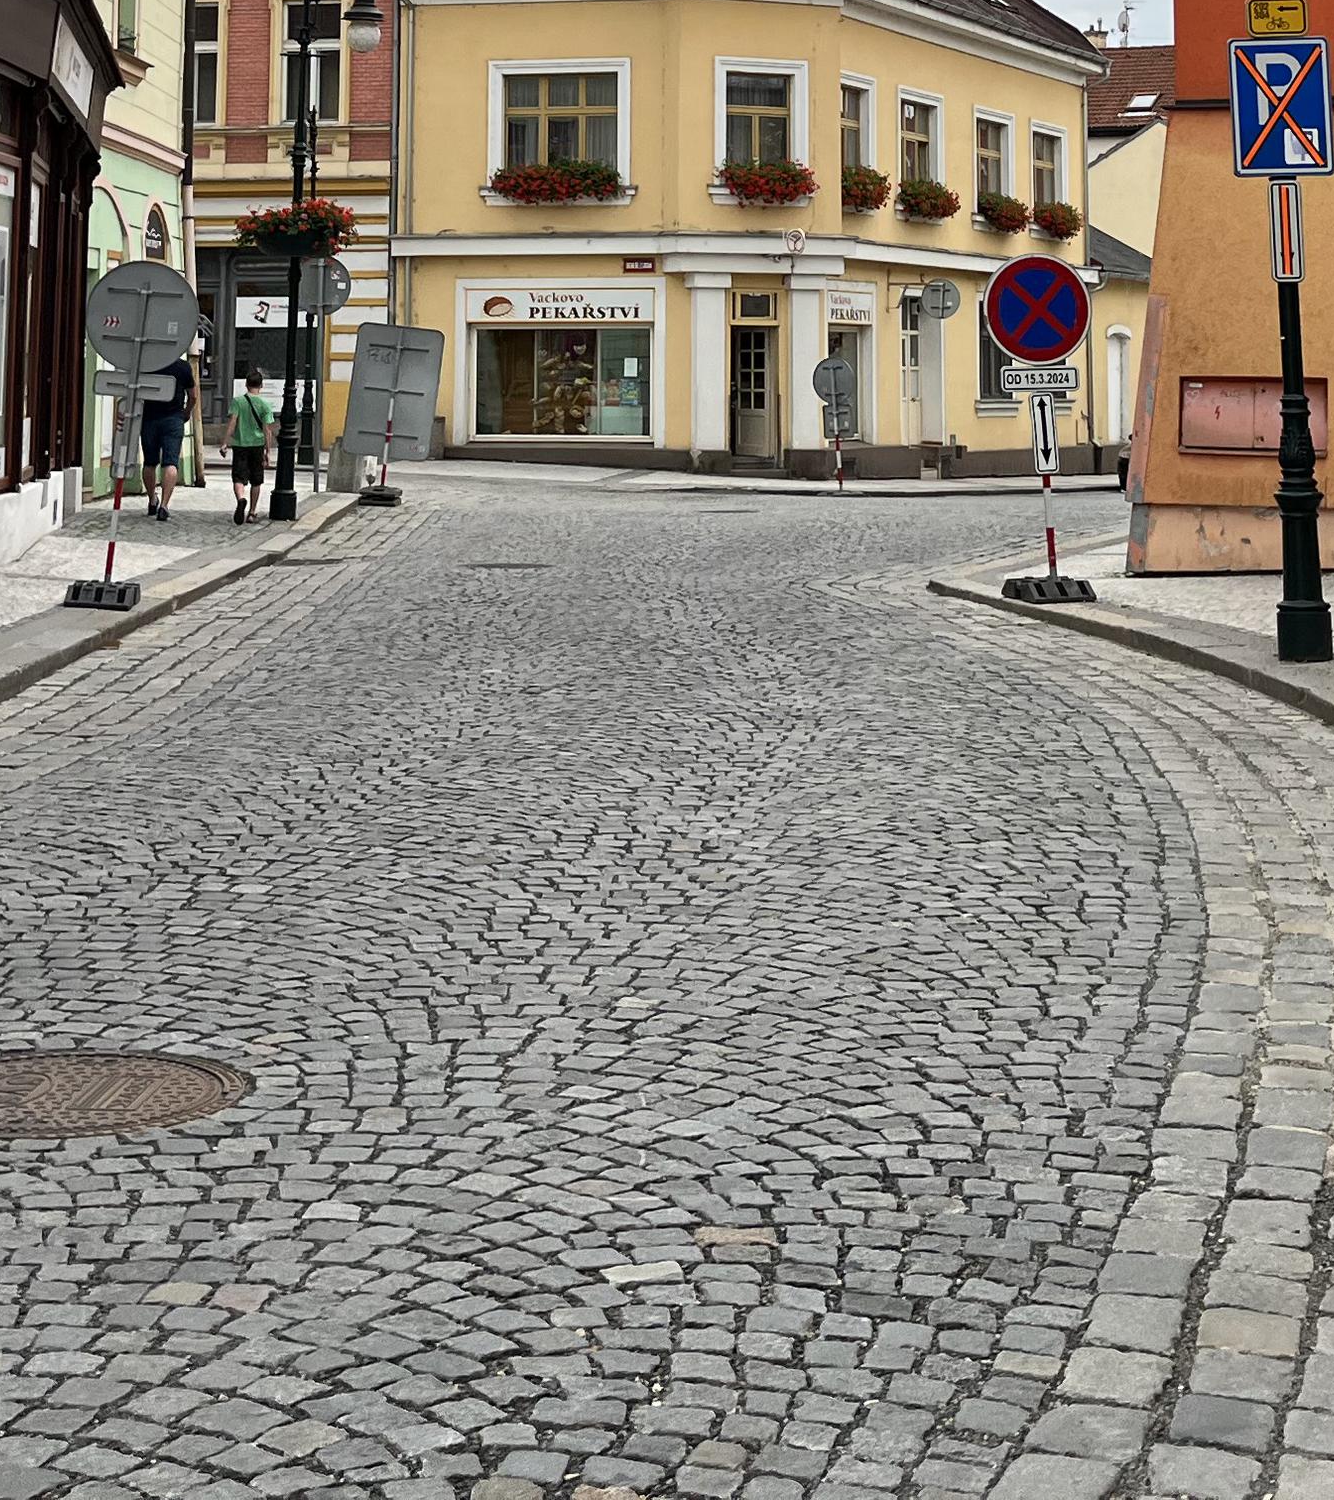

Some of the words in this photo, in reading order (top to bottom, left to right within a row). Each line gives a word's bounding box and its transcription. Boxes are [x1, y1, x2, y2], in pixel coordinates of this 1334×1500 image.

[1255, 52, 1302, 125] P
[529, 303, 640, 319] PEKAŘSTVÍ
[830, 306, 871, 322] PEKAŘSTVÍ
[1006, 374, 1022, 384] OD
[1024, 373, 1070, 384] 15.3.2024
